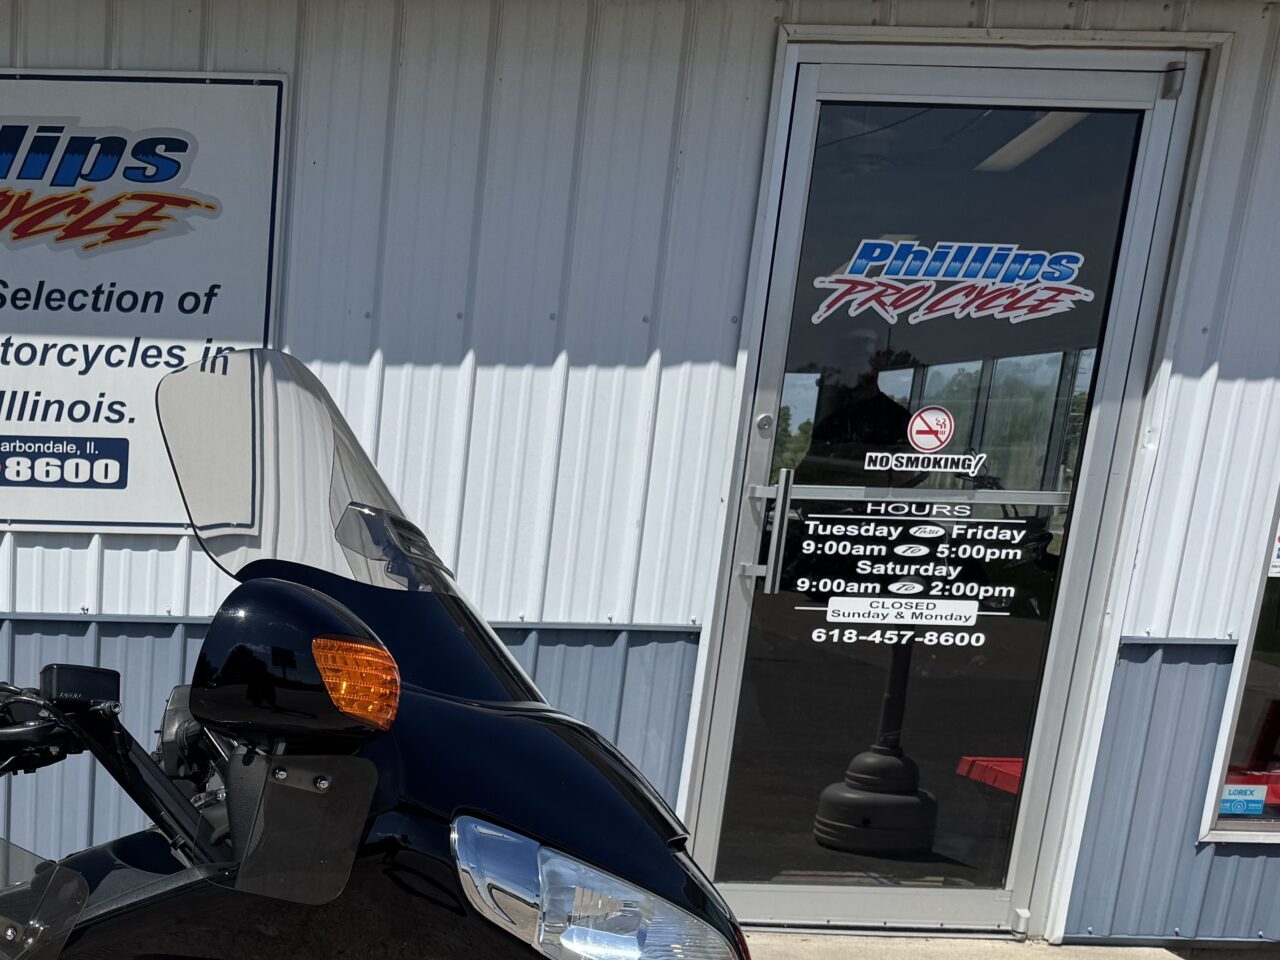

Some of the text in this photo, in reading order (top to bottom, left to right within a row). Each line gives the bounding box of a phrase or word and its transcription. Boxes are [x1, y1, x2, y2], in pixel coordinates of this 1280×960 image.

[848, 242, 1082, 283] Phillips
[176, 285, 221, 315] of
[815, 276, 1093, 323] PRO CYCLE
[200, 339, 237, 376] in
[868, 455, 985, 475] NO SMOKING!
[866, 502, 970, 516] HOURS
[805, 521, 903, 539] Tuesday
[952, 525, 1026, 544] Friday
[802, 540, 886, 556] 9:00am
[936, 544, 1022, 562] 5:00pm
[856, 560, 962, 579] Saturday
[796, 578, 880, 594] 9:00am
[929, 582, 1015, 599] 2:00pm
[831, 609, 889, 621] Sunday
[911, 612, 972, 623] Monday
[870, 601, 936, 611] CLOSED
[812, 629, 985, 646] 618-457-8600
[1228, 788, 1255, 797] LOREX
